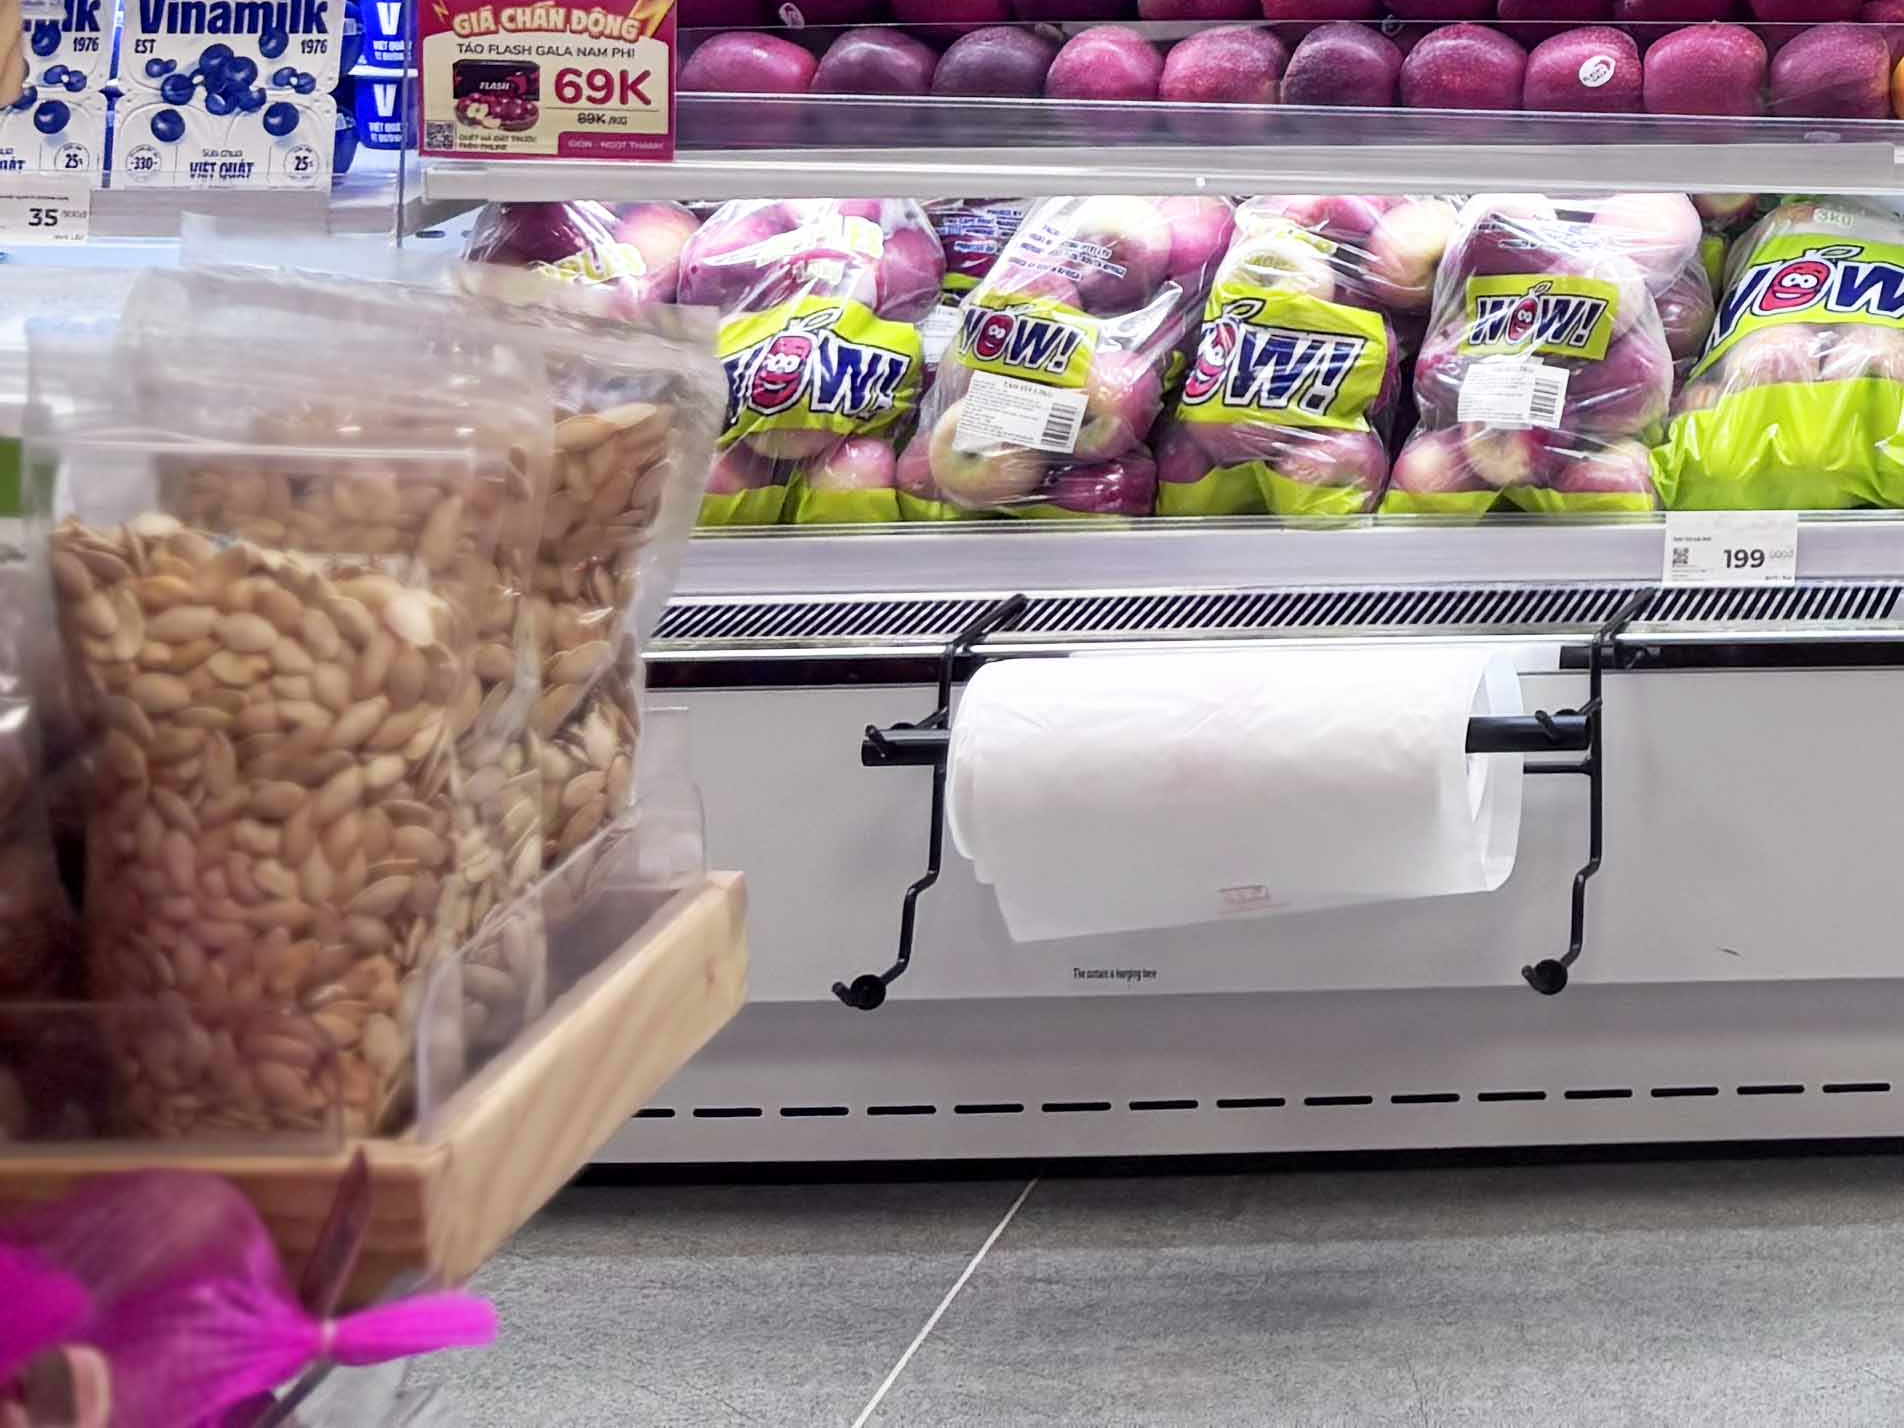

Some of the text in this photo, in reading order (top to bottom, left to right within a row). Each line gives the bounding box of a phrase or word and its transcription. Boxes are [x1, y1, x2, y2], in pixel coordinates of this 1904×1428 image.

[452, 0, 641, 41] GIÁ CHẤN ĐỘNG
[72, 37, 100, 52] 1976
[134, 38, 328, 54] EST 1976
[554, 67, 652, 106] 69K
[28, 208, 58, 228] 35
[1723, 549, 1765, 569] 199
